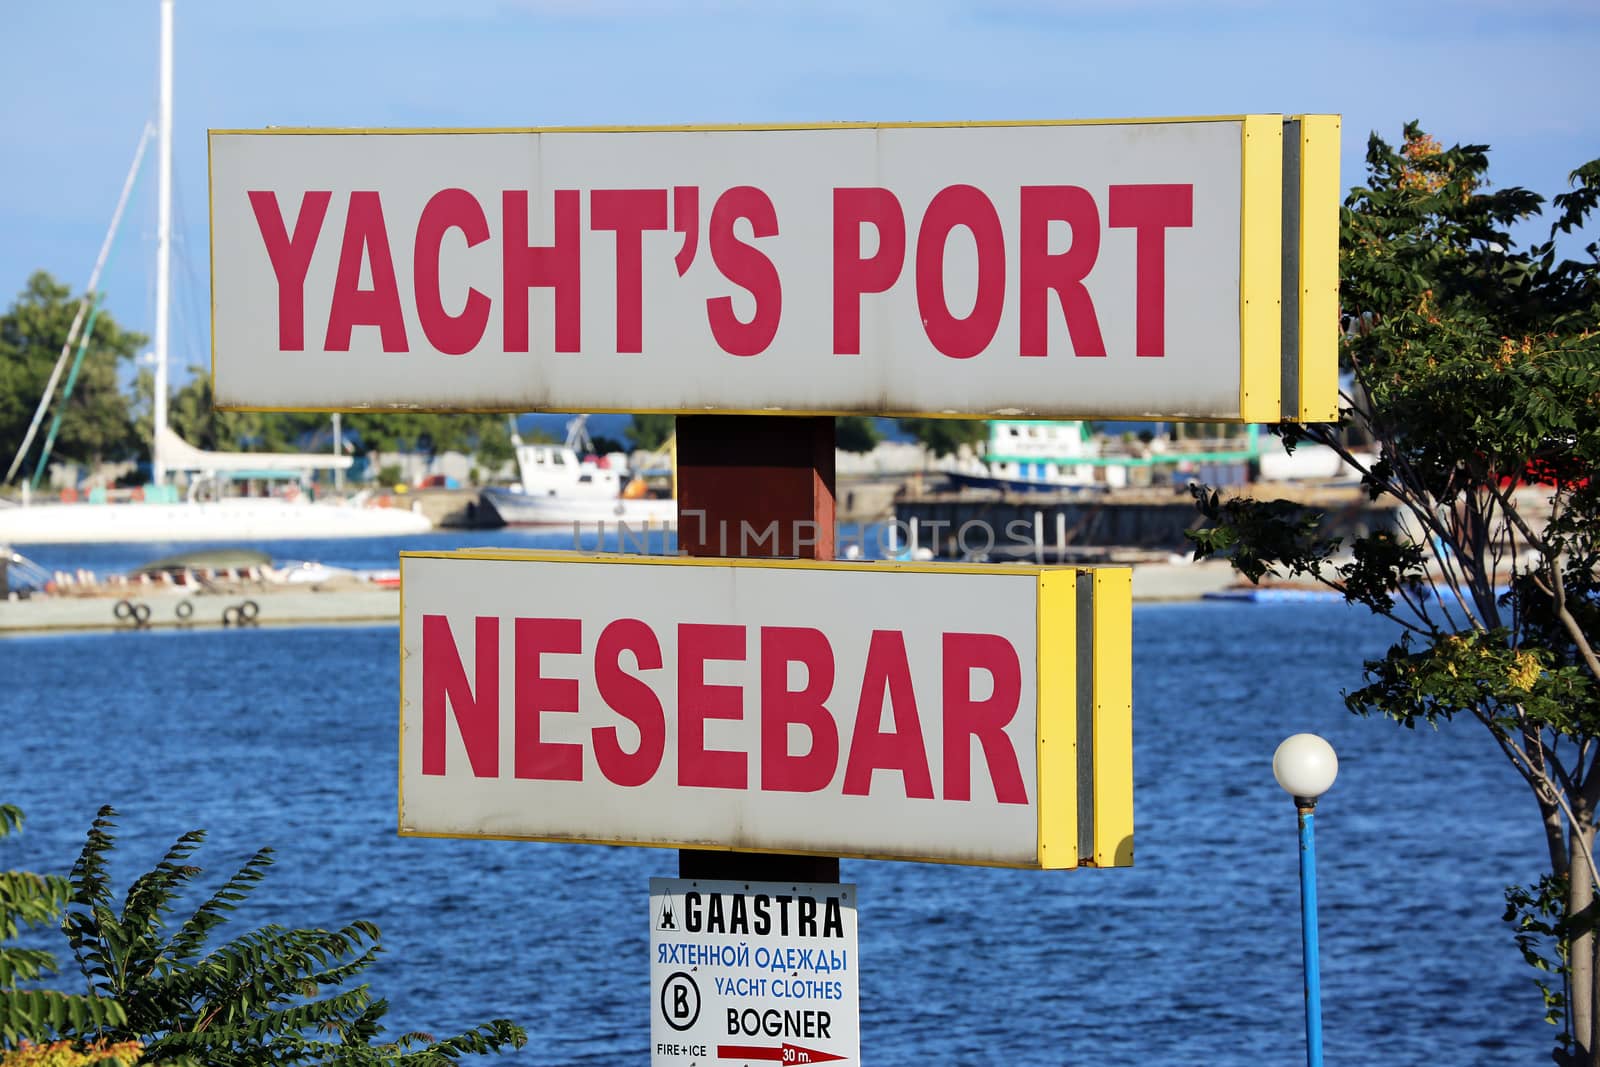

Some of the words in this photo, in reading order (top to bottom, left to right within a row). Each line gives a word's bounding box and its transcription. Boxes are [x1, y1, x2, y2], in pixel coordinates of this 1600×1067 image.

[248, 185, 782, 357] YACHT'S
[833, 184, 1193, 359] PORT
[423, 614, 1028, 804] NESEBAR
[685, 891, 844, 938] GAASTRA
[657, 942, 749, 967] ЯХТЕННОЙ
[754, 946, 847, 974] ОДЕЖДЫ
[715, 977, 767, 996] YACHT
[771, 979, 842, 1000] CLOTHES
[727, 1008, 831, 1039] BOGNER
[657, 1043, 707, 1057] FIRE+ICE
[782, 1048, 795, 1062] 30
